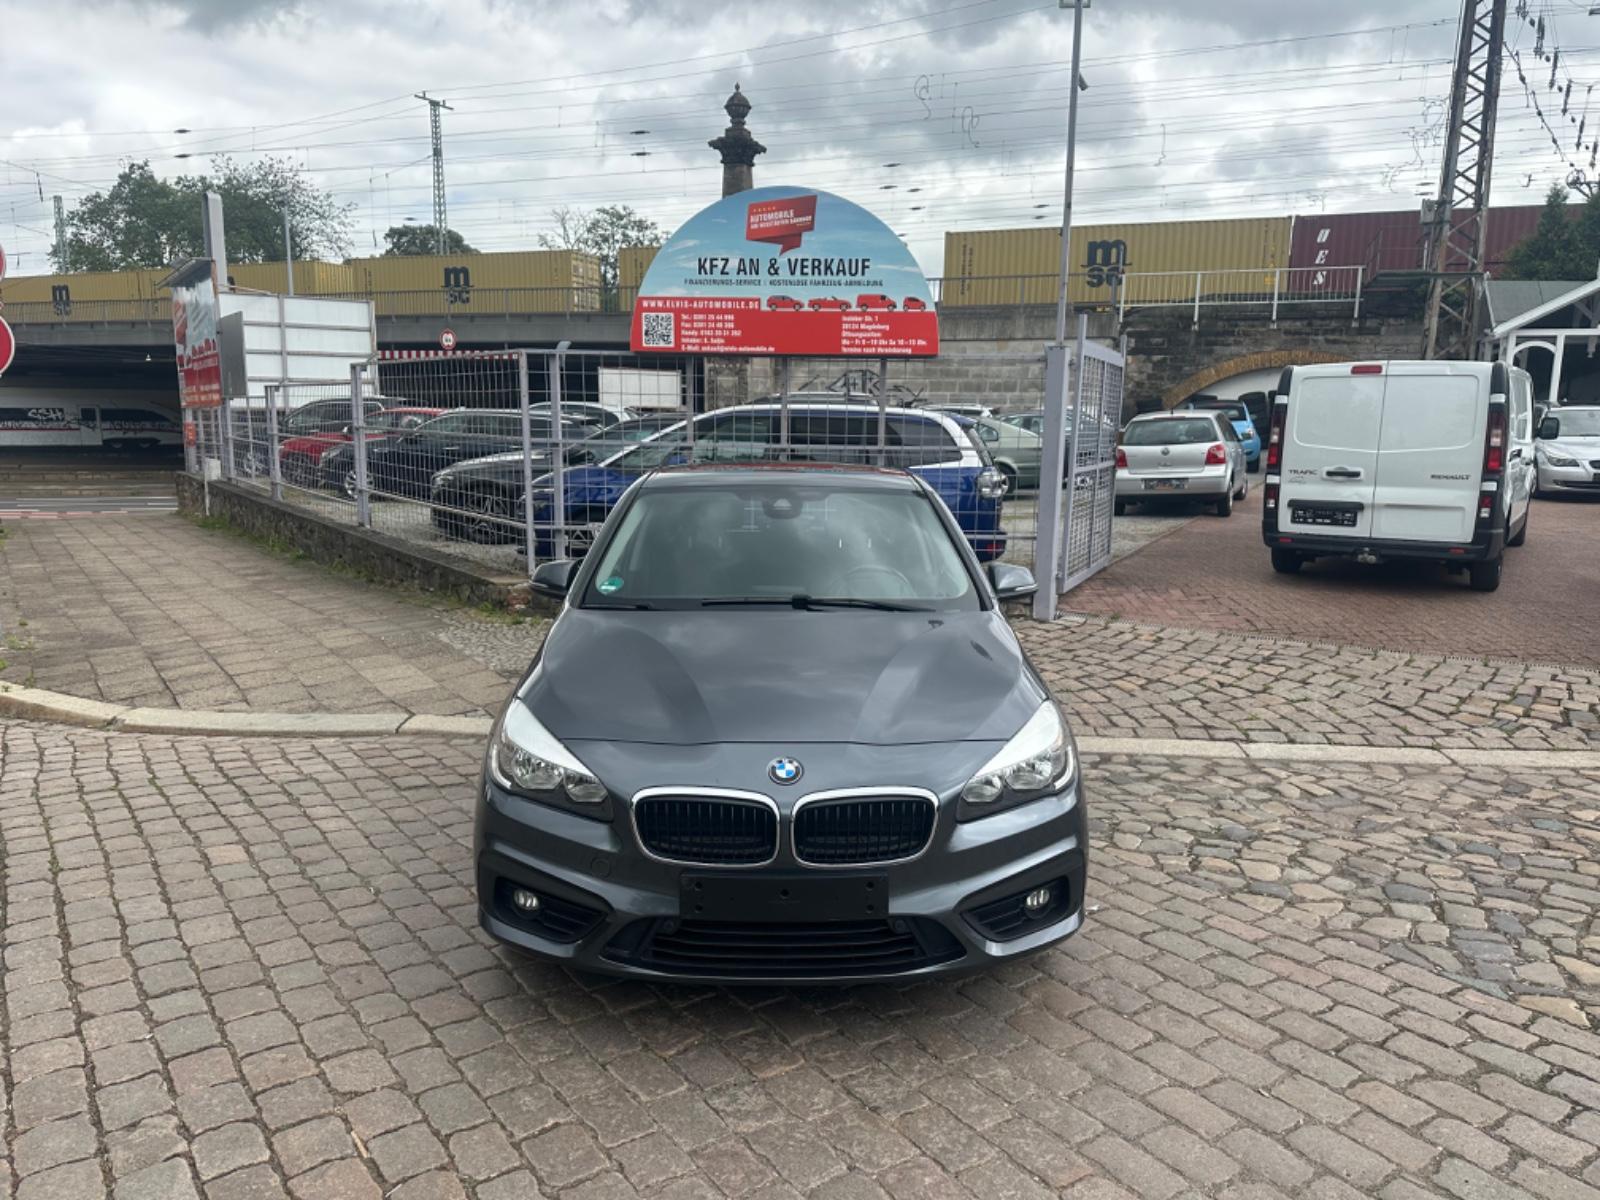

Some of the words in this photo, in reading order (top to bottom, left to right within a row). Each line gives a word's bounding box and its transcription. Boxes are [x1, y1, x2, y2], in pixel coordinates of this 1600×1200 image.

[750, 209, 795, 223] AUTOMOBILE
[697, 258, 730, 275] KFZ
[737, 258, 760, 276] AN
[768, 258, 780, 276] &
[787, 258, 871, 276] VERKAUF
[769, 279, 808, 287] KOSTENLOSE
[642, 300, 760, 309] WWW.ELVIS-AUTOMOBILE.DE
